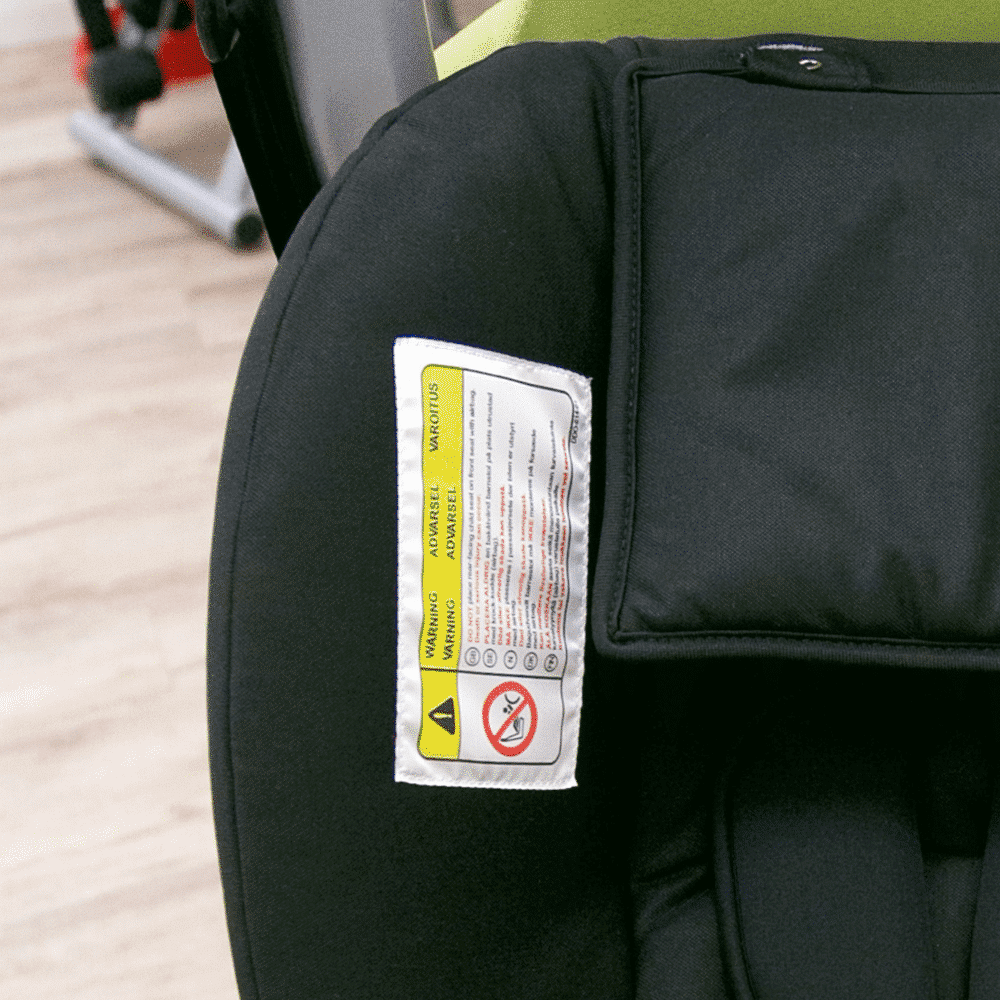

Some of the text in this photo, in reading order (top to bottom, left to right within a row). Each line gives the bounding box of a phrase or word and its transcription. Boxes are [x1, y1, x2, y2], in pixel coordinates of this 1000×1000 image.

[508, 422, 516, 448] utstyrt
[486, 452, 492, 463] på
[527, 466, 534, 477] på
[425, 382, 440, 659] WARNING ADVARSEL VAROITUS
[442, 487, 457, 661] VARNING ADVARSEL
